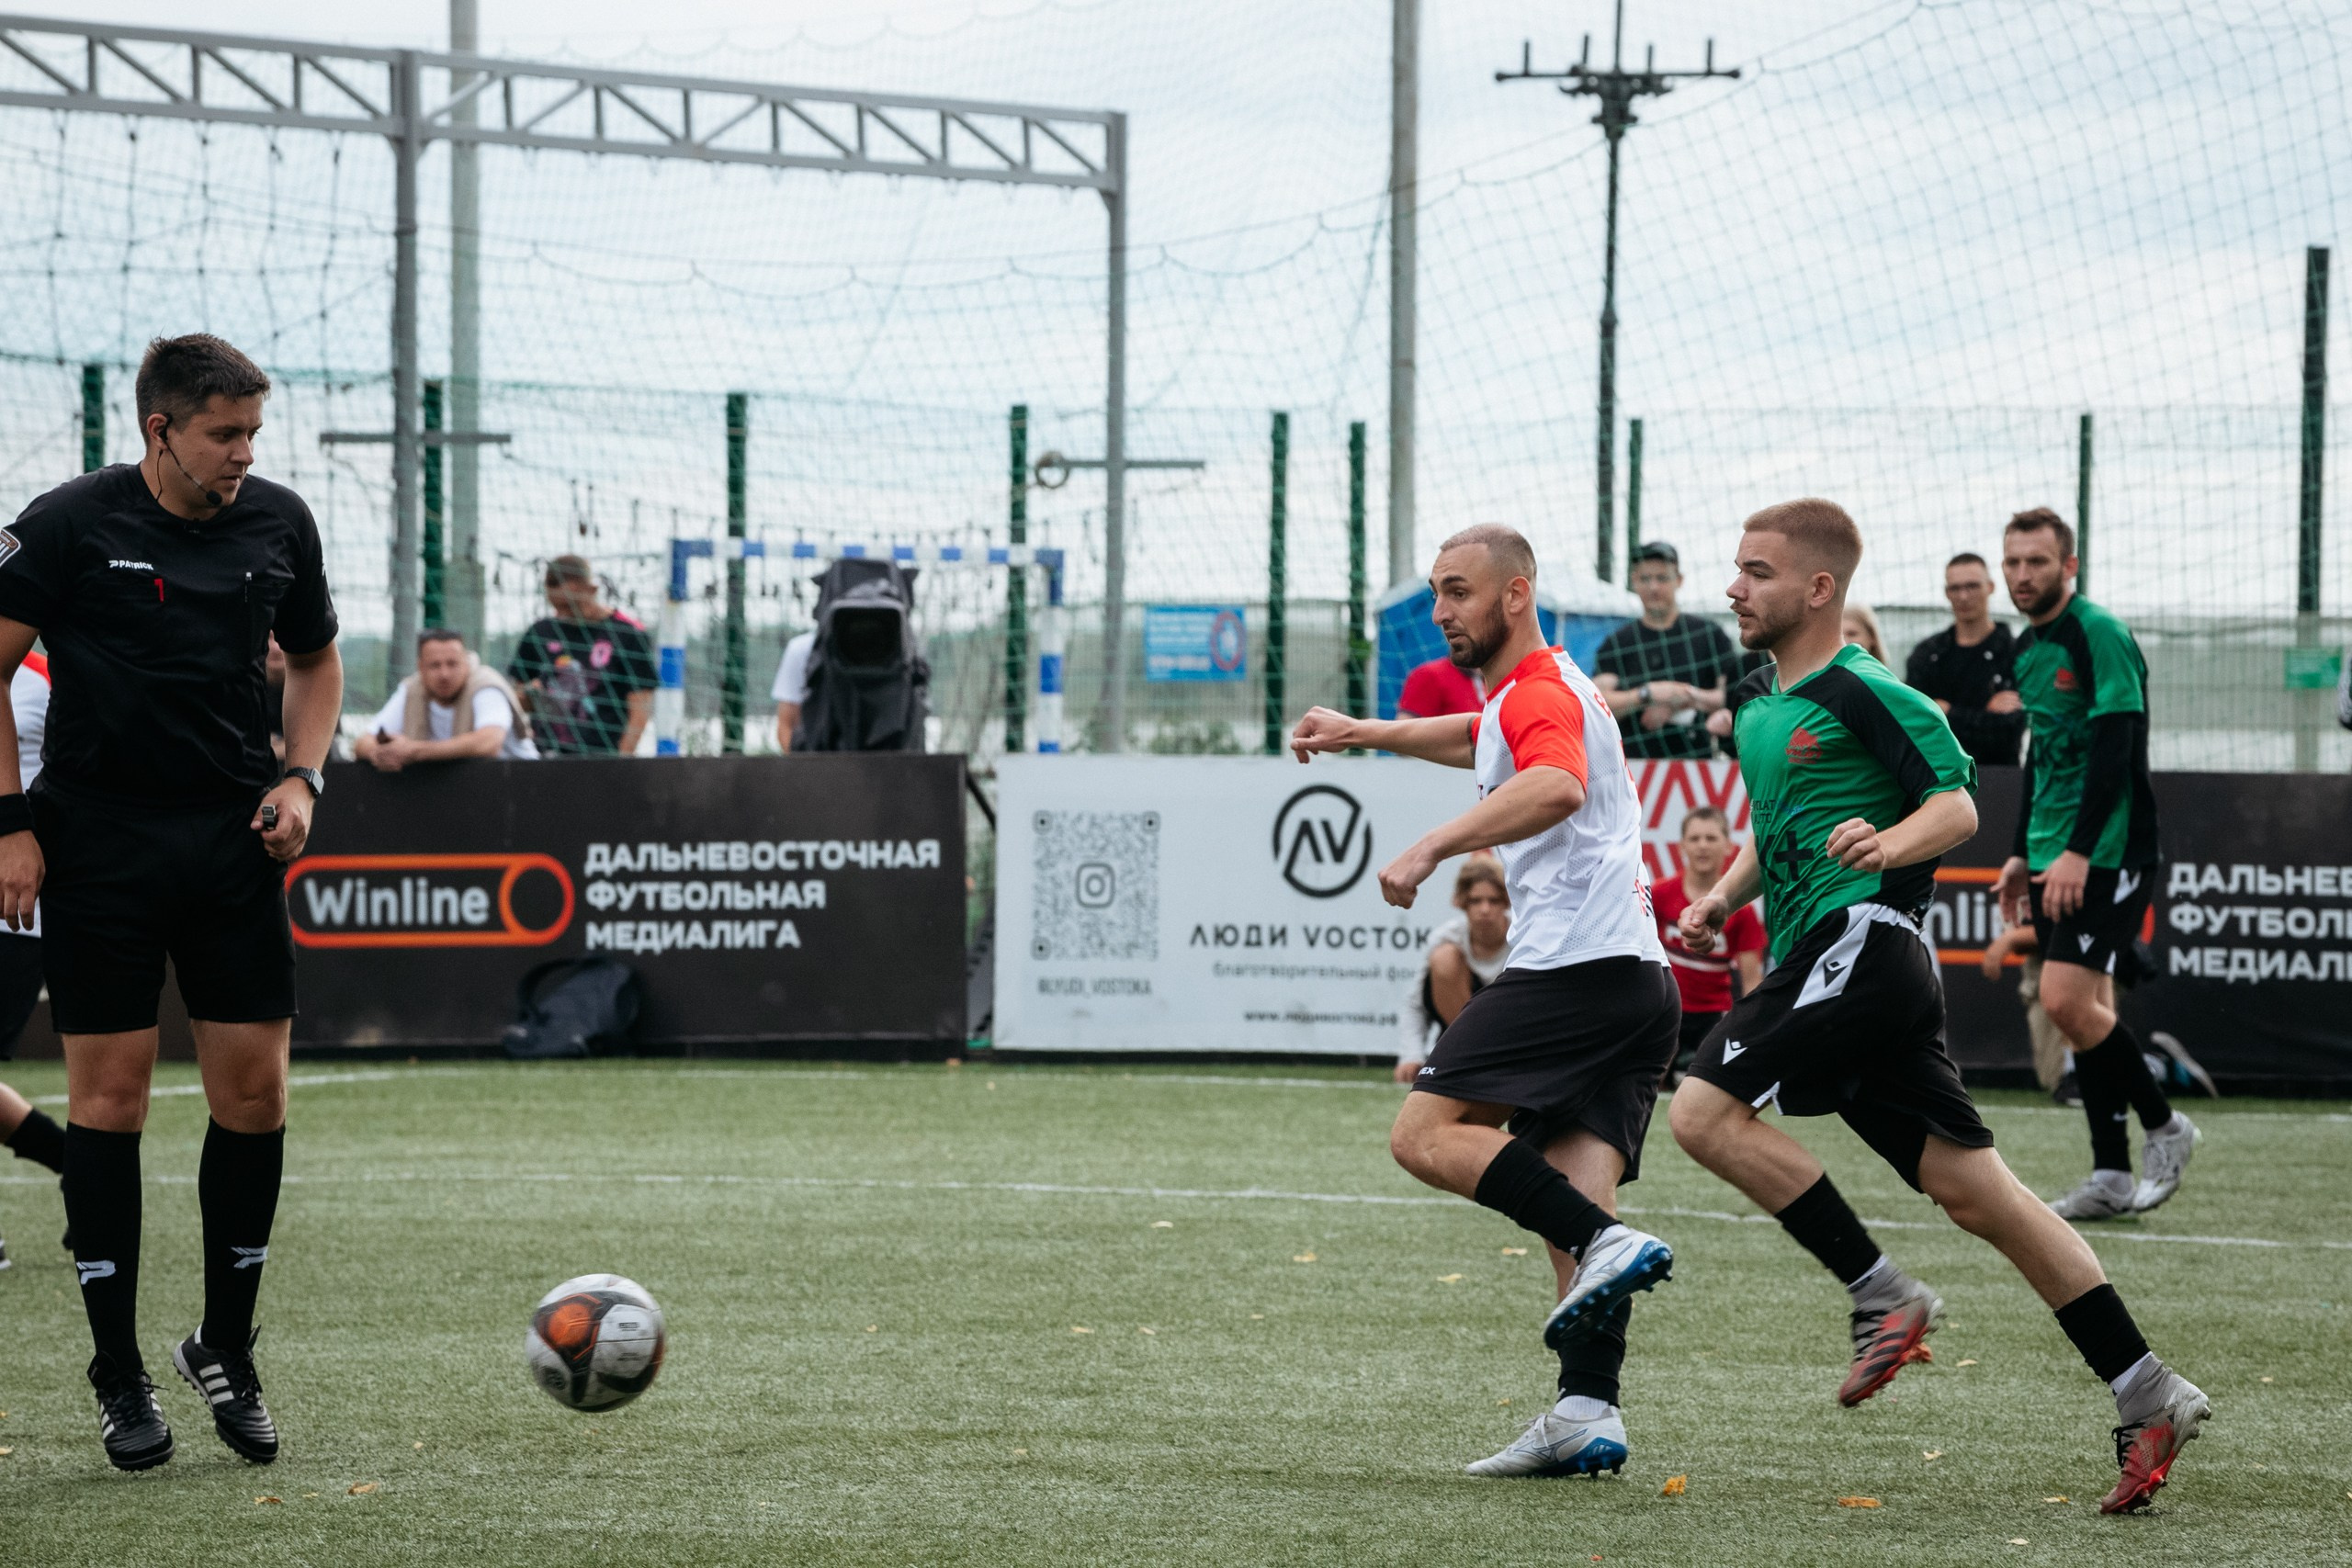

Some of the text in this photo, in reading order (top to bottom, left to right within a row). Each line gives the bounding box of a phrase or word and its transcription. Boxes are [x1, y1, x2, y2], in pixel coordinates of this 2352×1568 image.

[119, 559, 154, 570] PATRICK
[584, 840, 940, 877] ДАЛЬНЕВОСТОЧНАЯ
[303, 876, 490, 926] Winline
[585, 879, 826, 911] ФУТБОЛЬНАЯ
[585, 919, 801, 955] МЕДИАЛИГА
[1190, 923, 1432, 950] ЛЮДИ VОСТОК
[2169, 901, 2352, 939] ФУТБОЛ
[2169, 945, 2352, 984] МЕДИАЛ
